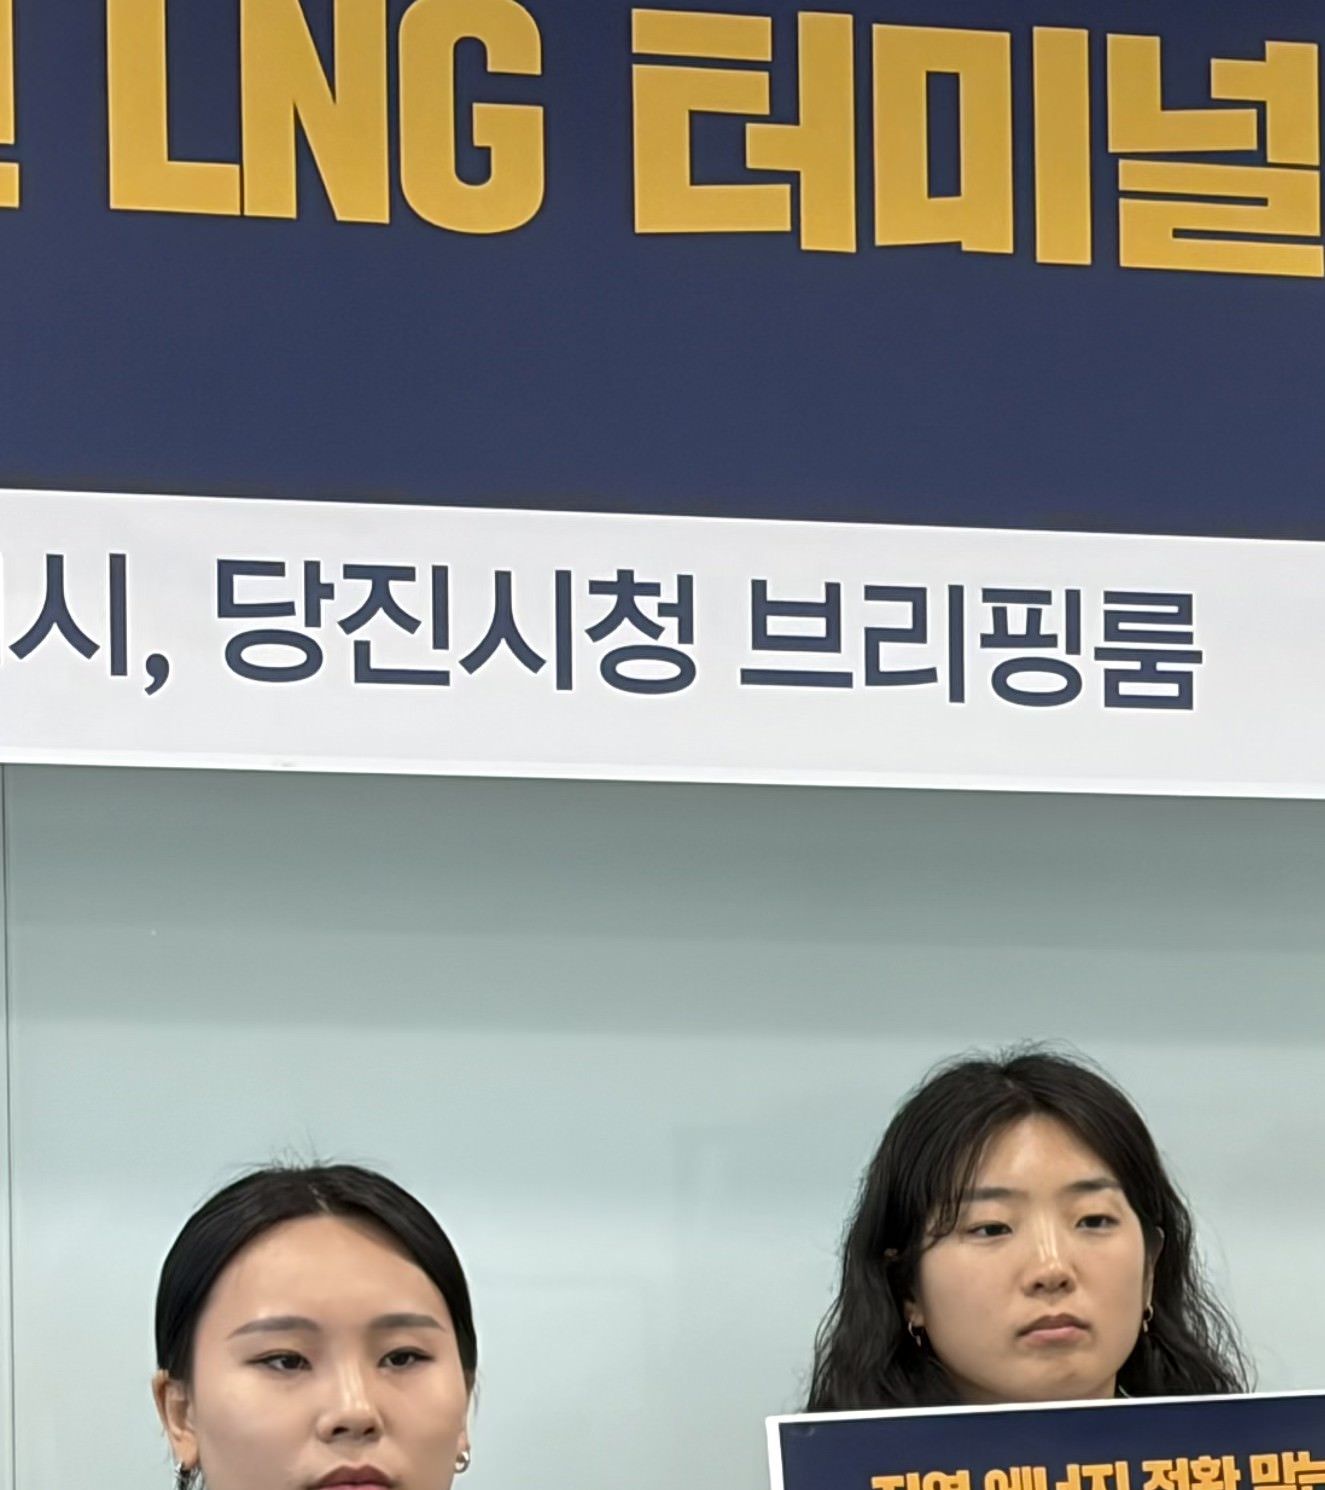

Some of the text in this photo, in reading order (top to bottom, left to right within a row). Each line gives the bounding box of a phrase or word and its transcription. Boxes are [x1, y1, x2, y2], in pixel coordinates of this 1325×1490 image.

[105, 0, 545, 234] LNG
[630, 7, 1325, 277] 터미널
[215, 556, 698, 694] 당진시청
[740, 578, 1204, 711] 브리핑룸
